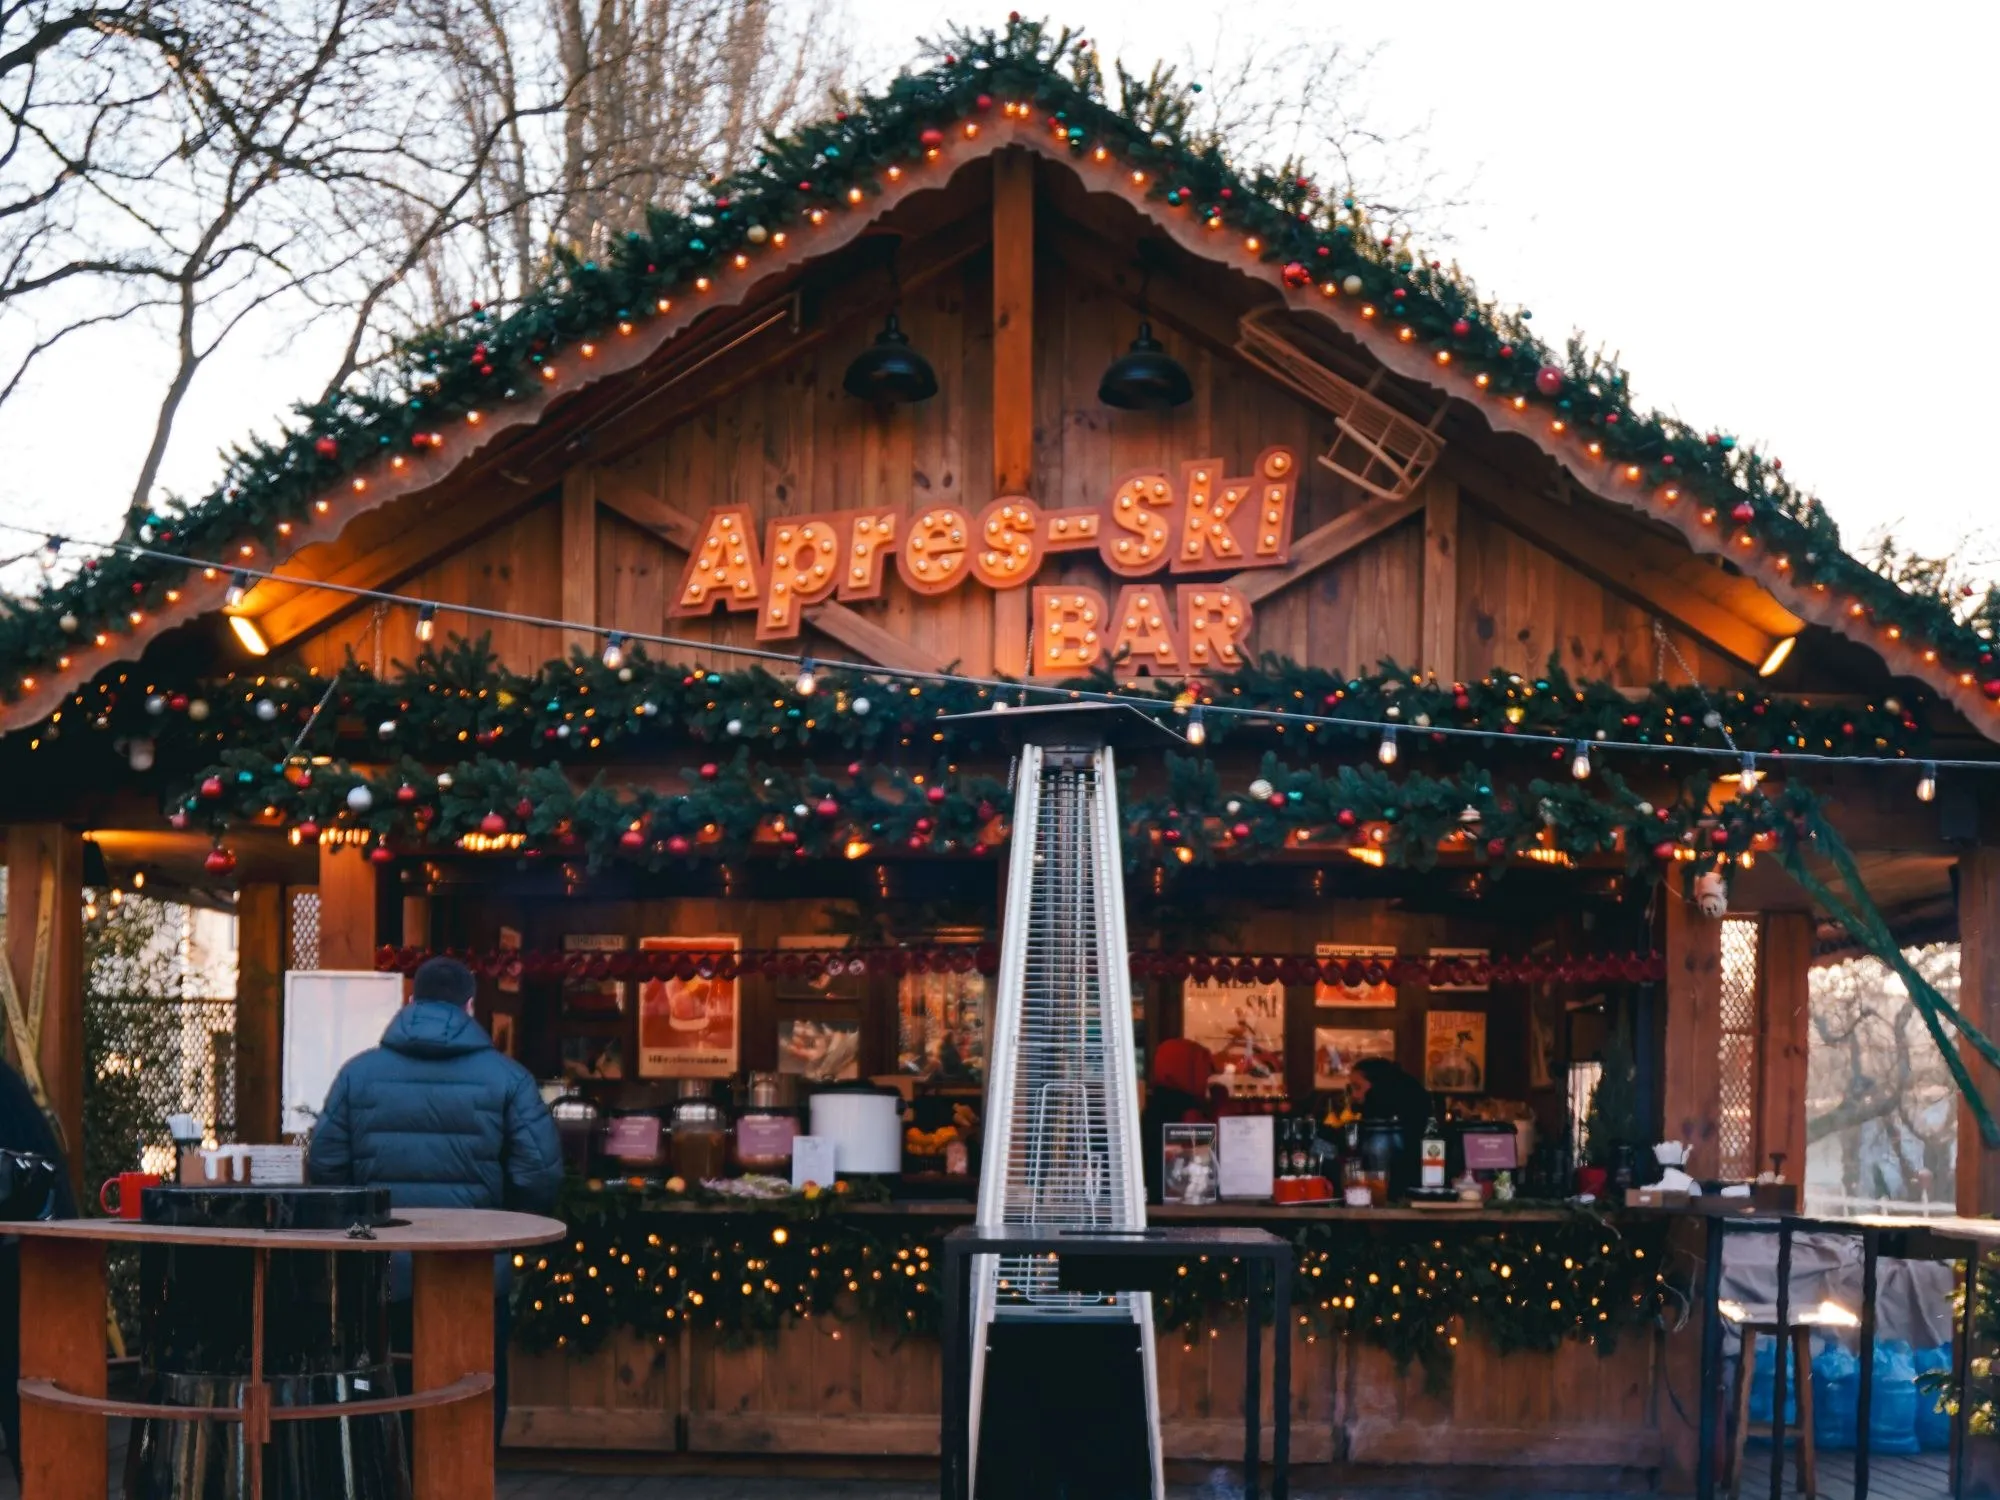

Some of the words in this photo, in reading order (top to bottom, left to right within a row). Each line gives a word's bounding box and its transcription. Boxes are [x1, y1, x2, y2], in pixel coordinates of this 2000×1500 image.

[679, 450, 1293, 628] Apres-Ski
[1043, 592, 1245, 668] BAR
[1245, 994, 1276, 1018] SKI
